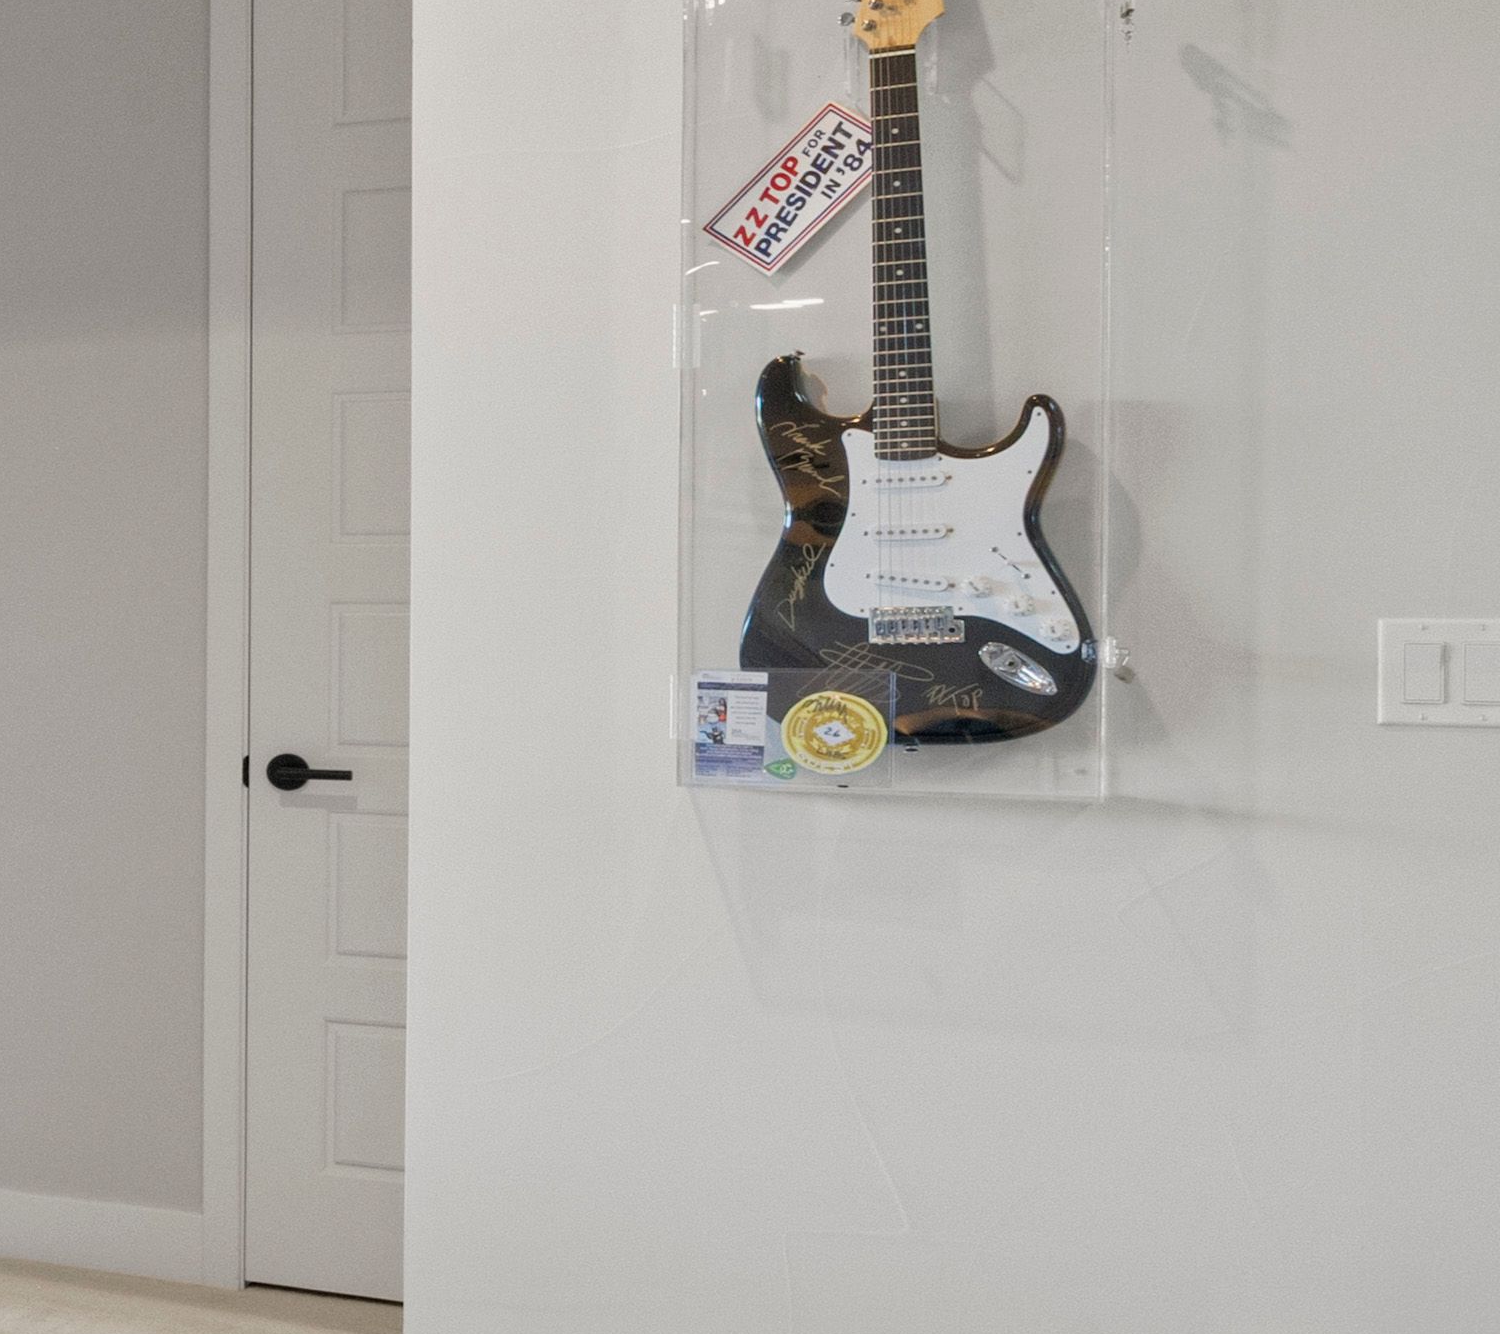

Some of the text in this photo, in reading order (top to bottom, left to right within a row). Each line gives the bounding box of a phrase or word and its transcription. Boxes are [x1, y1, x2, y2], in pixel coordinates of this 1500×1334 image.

[754, 120, 853, 258] PRESIDENT
[759, 156, 799, 205] TOP
[802, 129, 826, 157] FOR
[820, 138, 872, 200] IN '84
